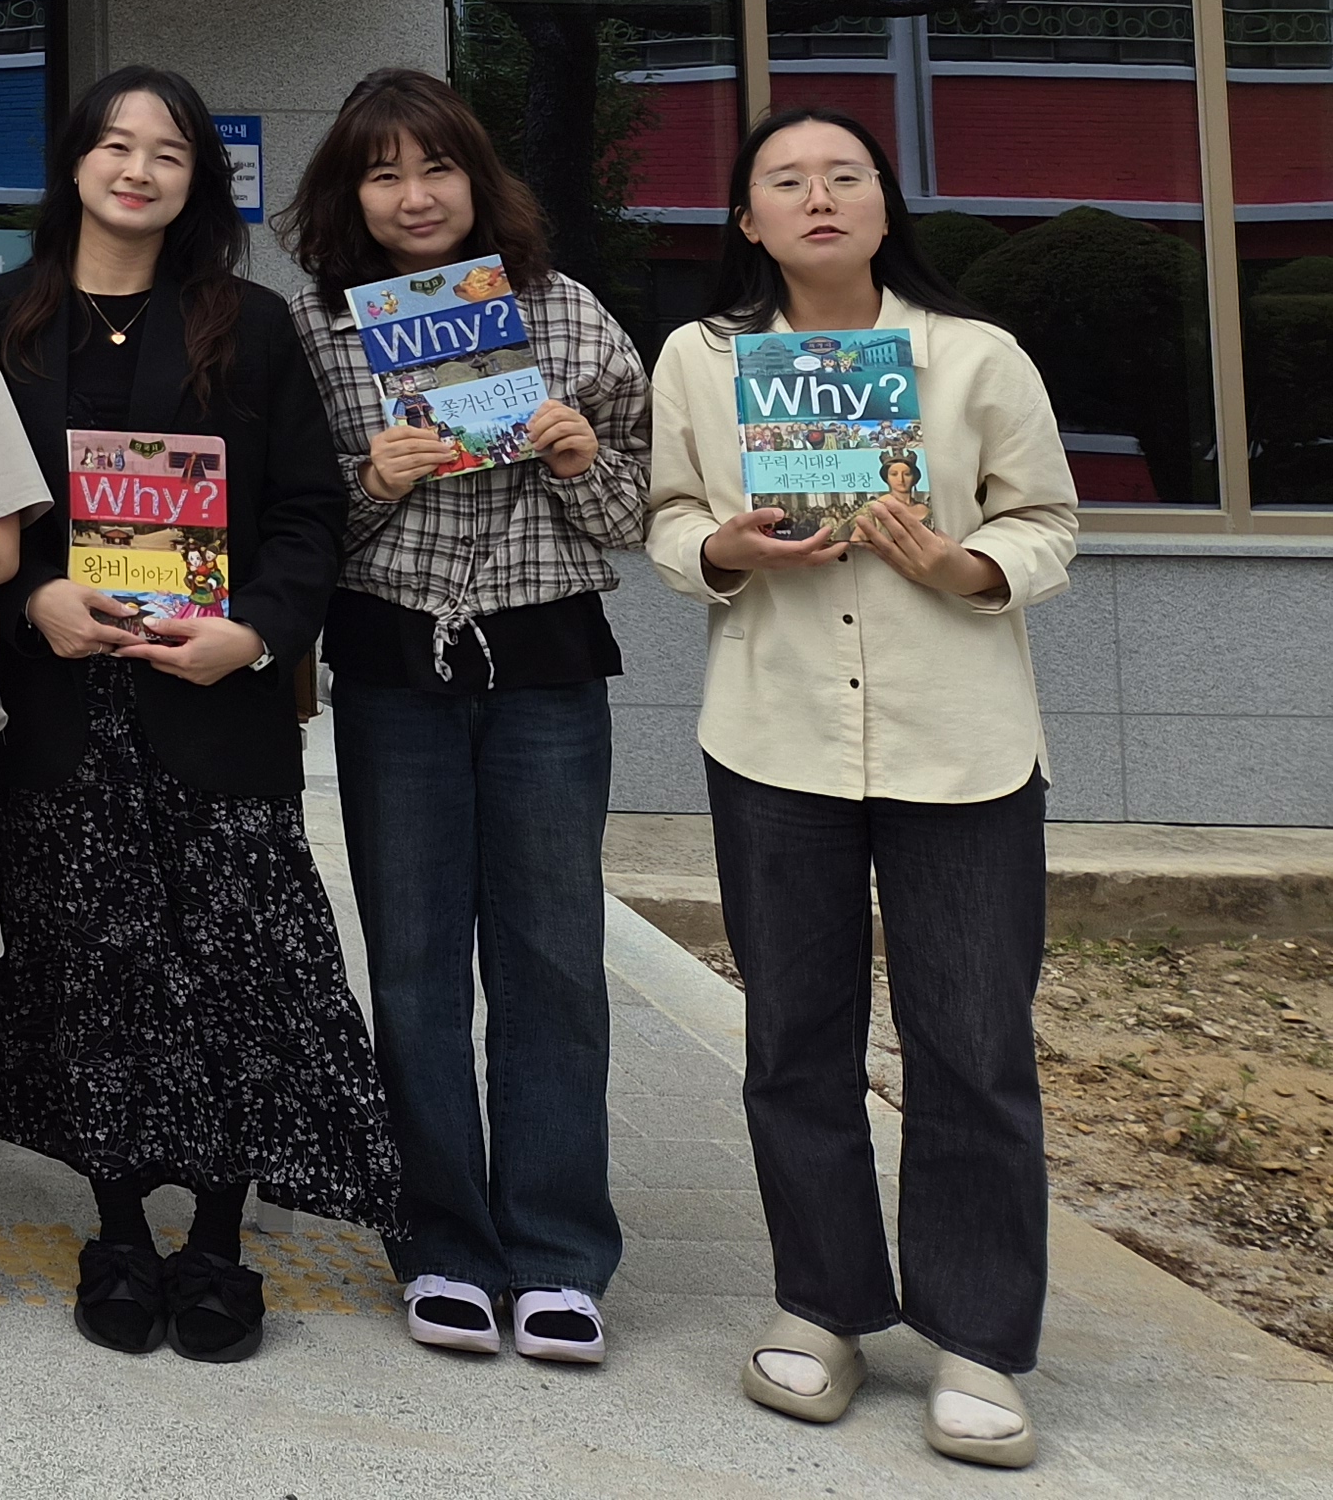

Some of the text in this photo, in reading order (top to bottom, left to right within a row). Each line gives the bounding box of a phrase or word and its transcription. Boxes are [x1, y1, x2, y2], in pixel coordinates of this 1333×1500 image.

[215, 124, 247, 138] 안내
[371, 299, 510, 364] Why?
[440, 374, 540, 420] 쫓겨난 임금
[749, 372, 908, 420] Why?
[758, 453, 841, 470] 무력 시대와
[773, 472, 873, 490] 제국주의 팽창
[80, 476, 219, 523] Why?
